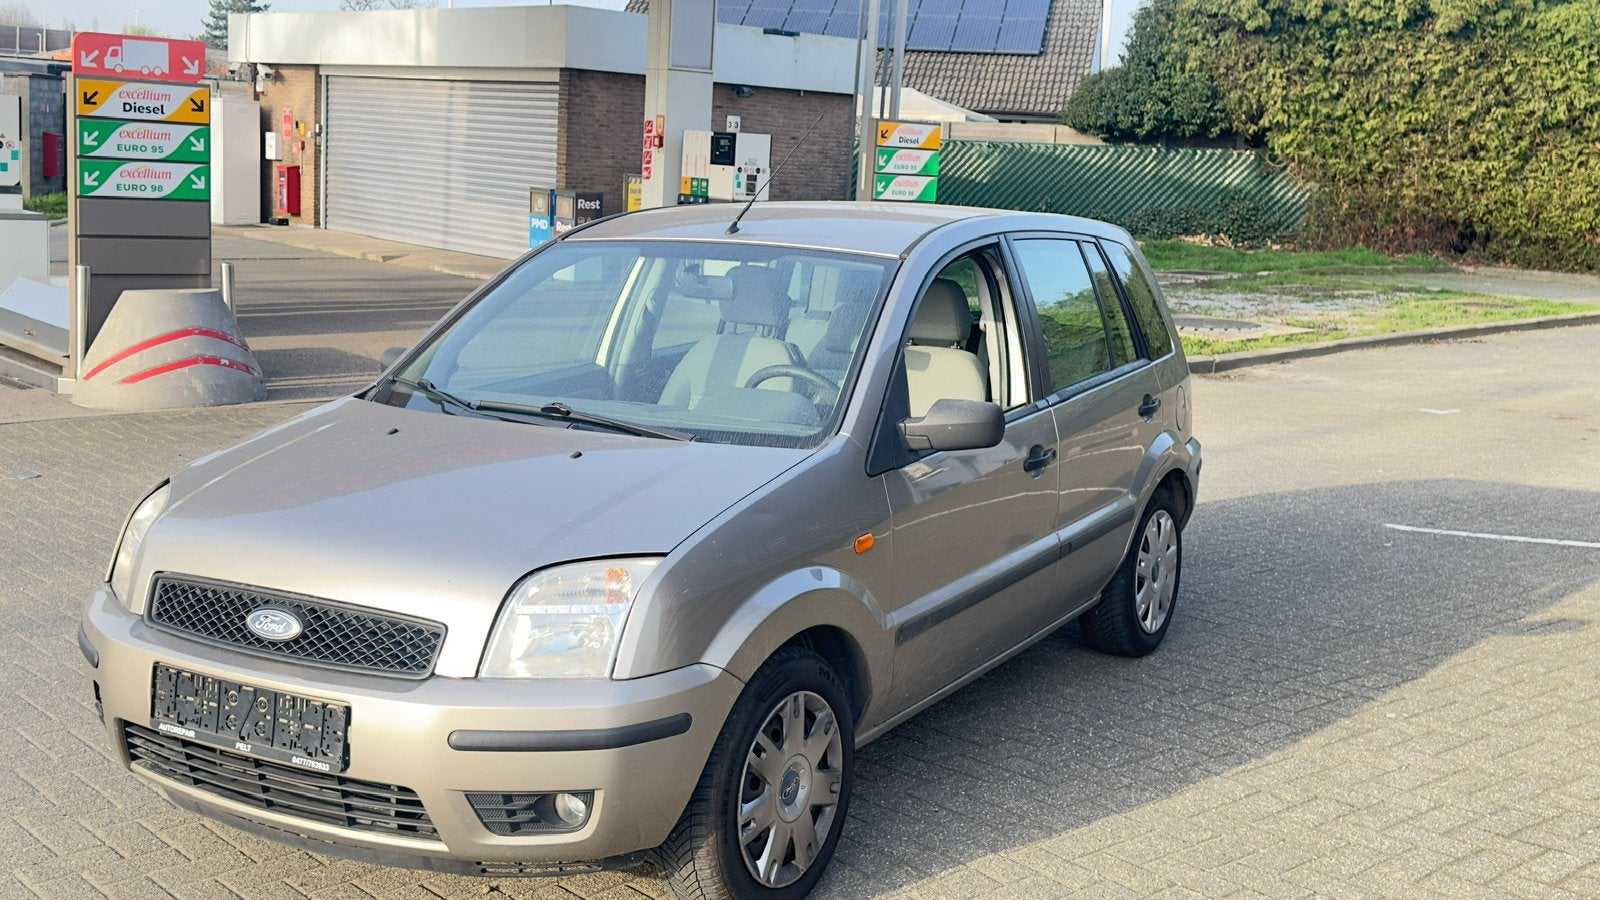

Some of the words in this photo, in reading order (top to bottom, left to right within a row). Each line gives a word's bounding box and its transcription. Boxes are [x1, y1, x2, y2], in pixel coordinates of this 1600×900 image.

[119, 89, 171, 101] excellium
[122, 102, 165, 115] Diesel
[119, 128, 171, 140] excellium
[898, 136, 919, 144] Diesel
[117, 143, 147, 153] EURO
[151, 145, 164, 154] 95
[119, 167, 172, 180] excellium
[116, 183, 147, 192] EURO
[150, 184, 164, 193] 98
[577, 199, 600, 209] Rest
[531, 218, 548, 229] PMD
[255, 614, 288, 633] Ford
[158, 723, 196, 738] AUTOREPAIR
[235, 741, 252, 752] PELT
